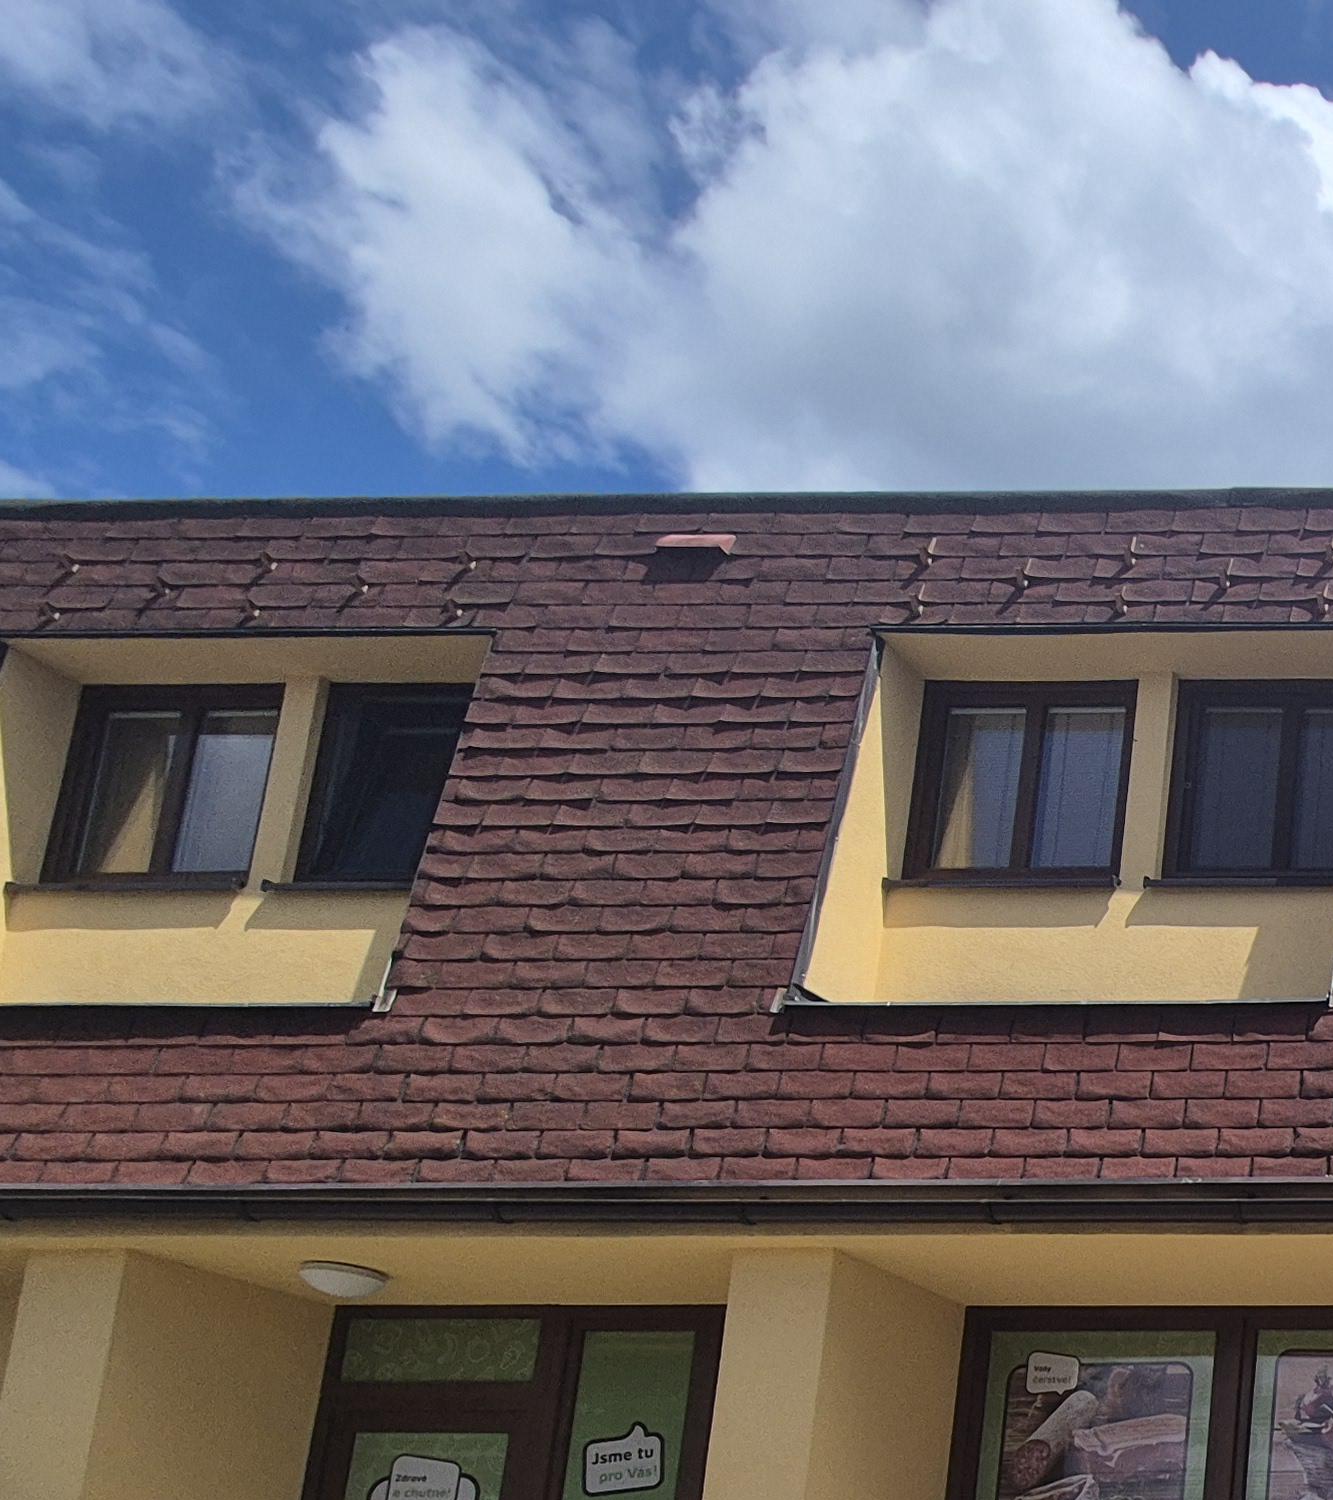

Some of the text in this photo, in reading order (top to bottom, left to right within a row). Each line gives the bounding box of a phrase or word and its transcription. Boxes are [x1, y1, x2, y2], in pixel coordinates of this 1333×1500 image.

[592, 1447, 653, 1465] Jsme tu
[600, 1472, 622, 1485] pro
